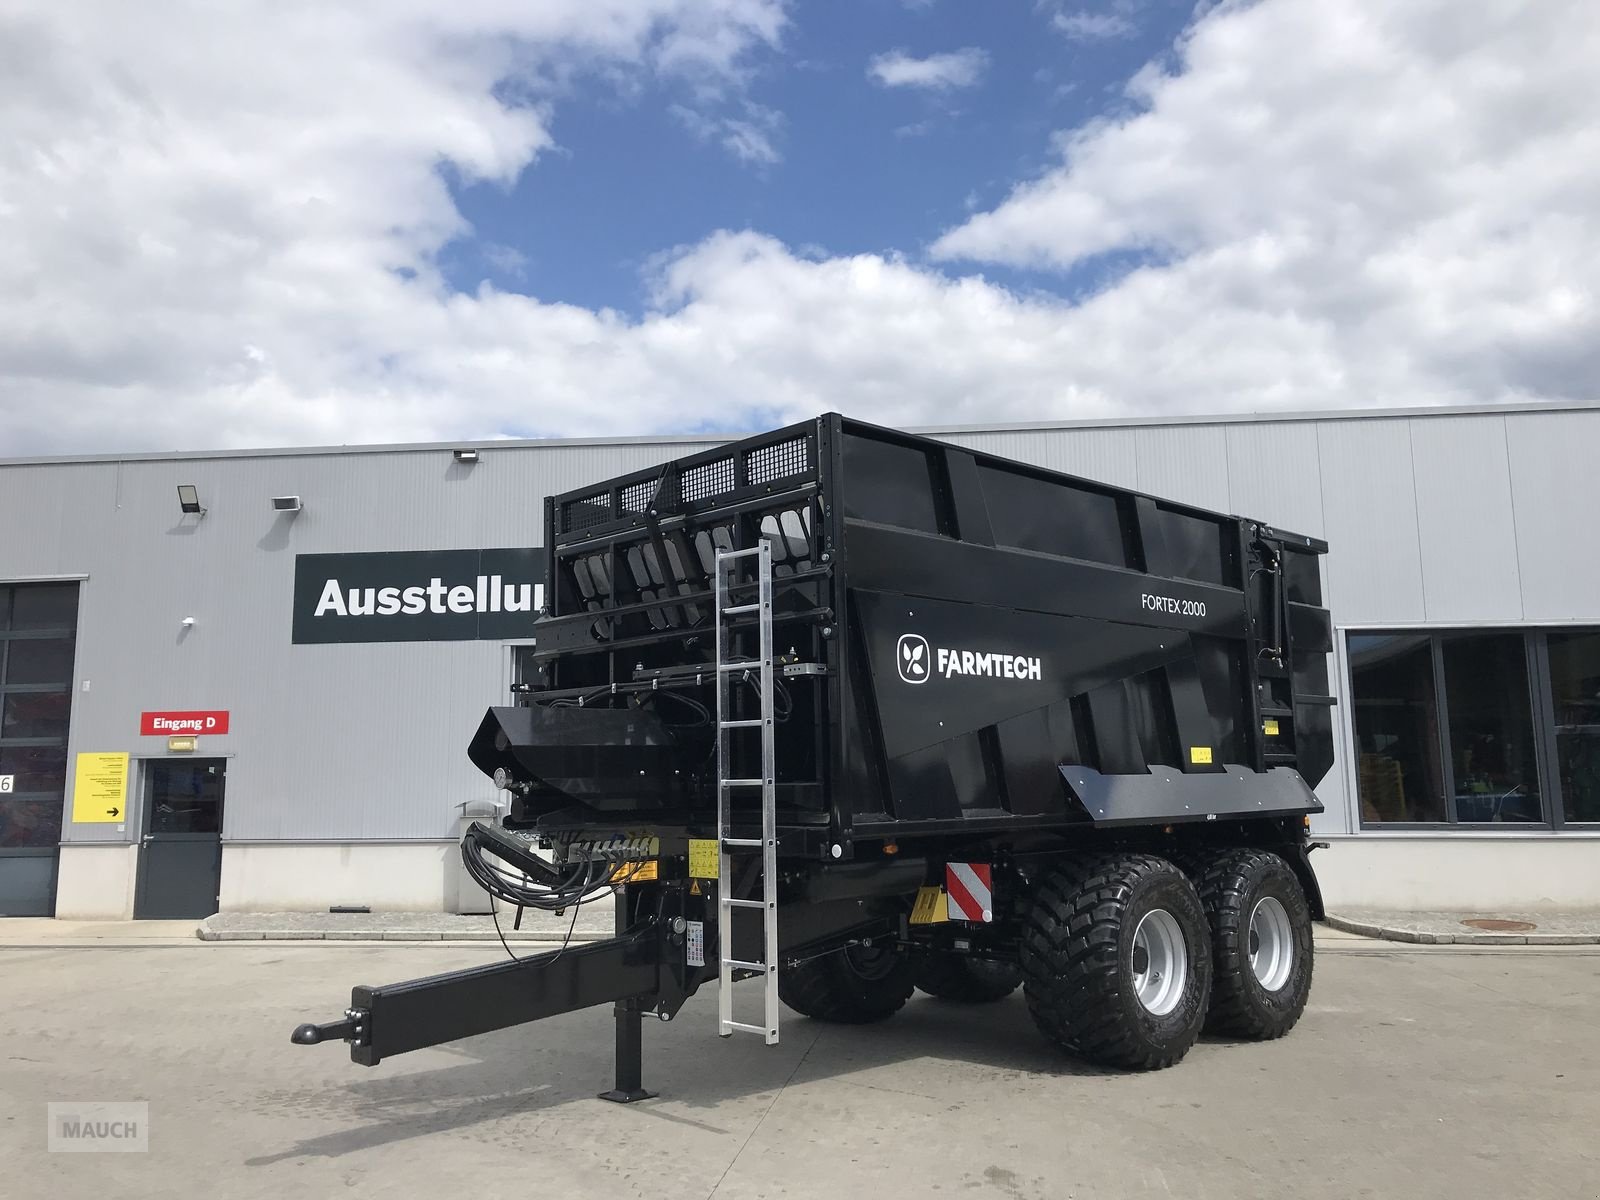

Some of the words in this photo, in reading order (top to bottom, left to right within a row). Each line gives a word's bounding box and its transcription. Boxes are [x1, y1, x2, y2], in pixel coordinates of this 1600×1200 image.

[1141, 594, 1181, 614] FORTEX
[1182, 600, 1206, 617] 2000
[937, 648, 1041, 680] FARMTECH
[153, 717, 202, 730] Eingang
[206, 717, 215, 727] D
[1, 777, 10, 791] 6
